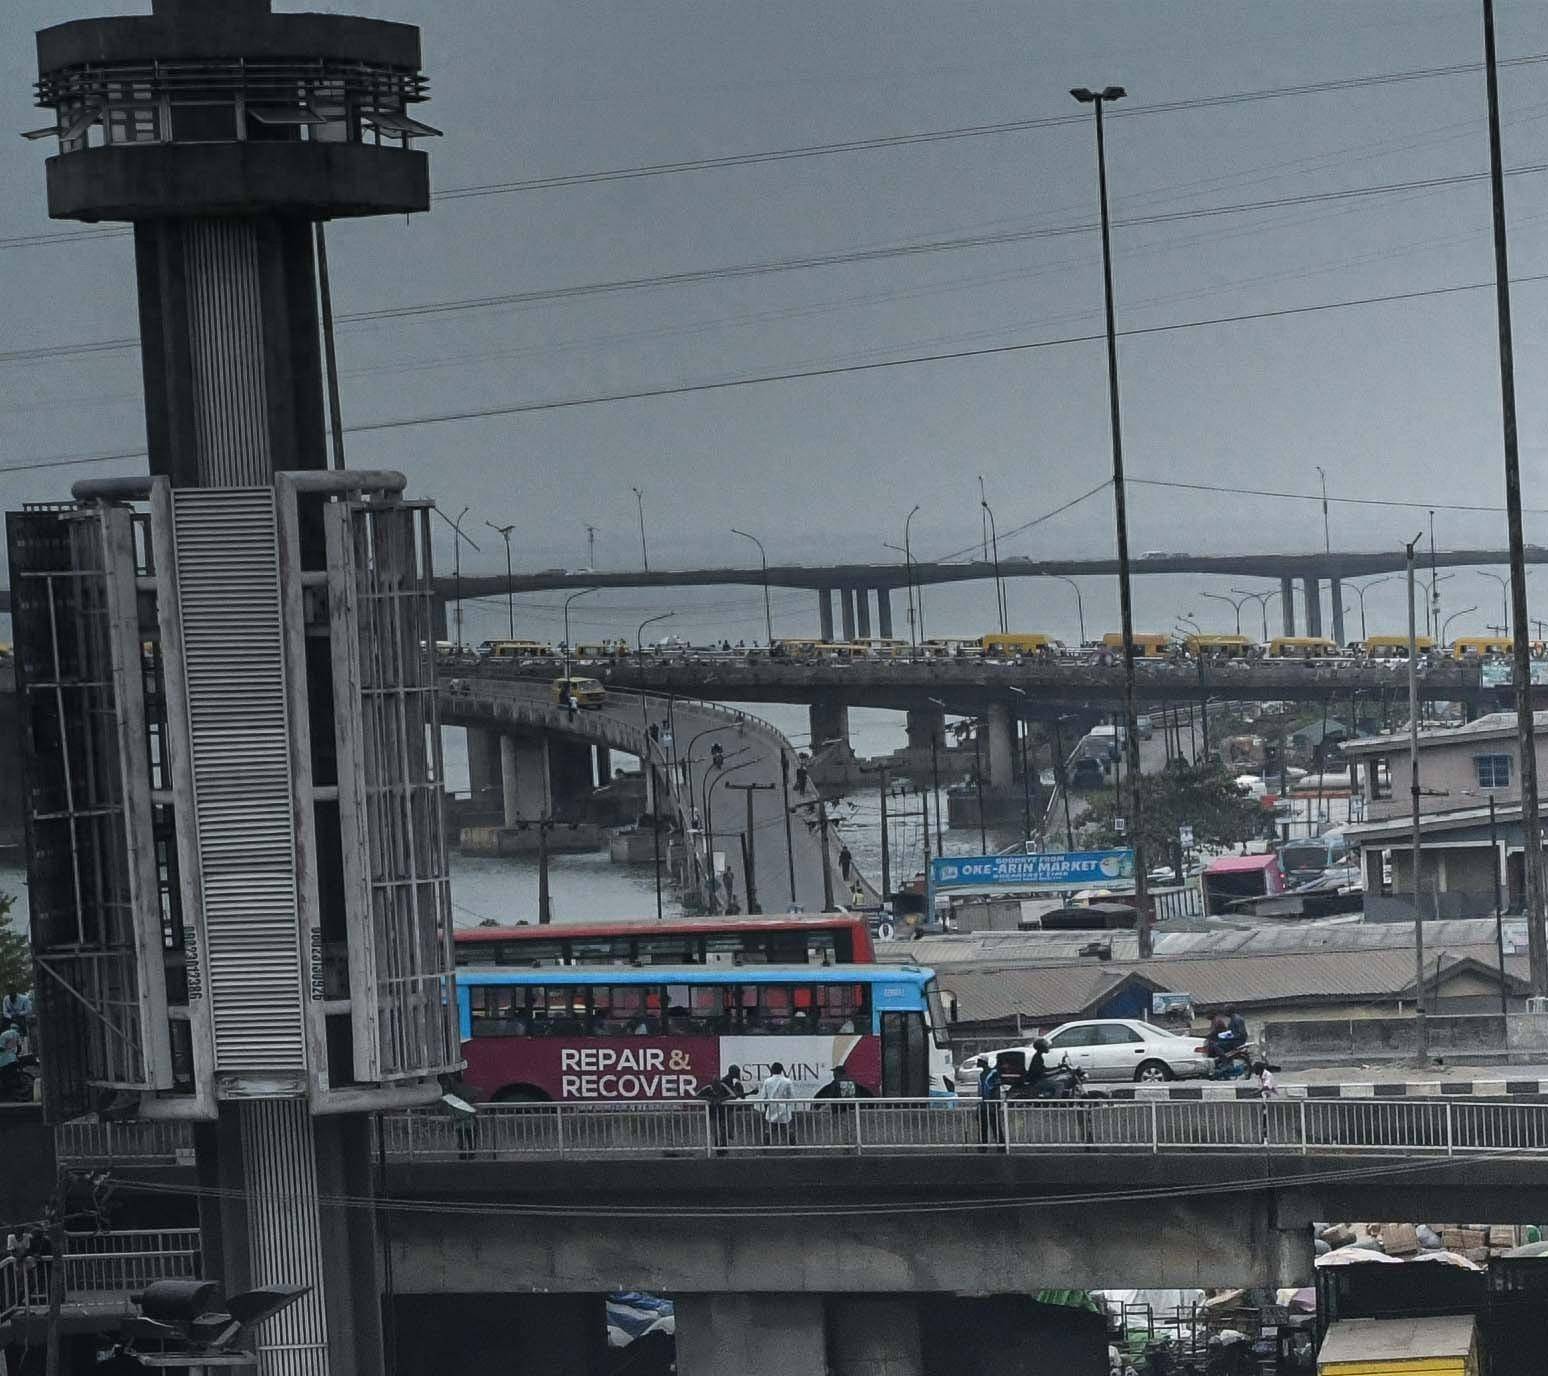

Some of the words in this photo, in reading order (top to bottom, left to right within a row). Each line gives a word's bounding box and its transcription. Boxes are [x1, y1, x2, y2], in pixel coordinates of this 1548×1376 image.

[961, 863, 1034, 877] OKE-ARIN
[1037, 859, 1098, 874] MARKET
[561, 1048, 664, 1071] REPAIR
[668, 1049, 692, 1071] &
[740, 1063, 821, 1082] STYMIN
[562, 1075, 697, 1098] RECOVER
